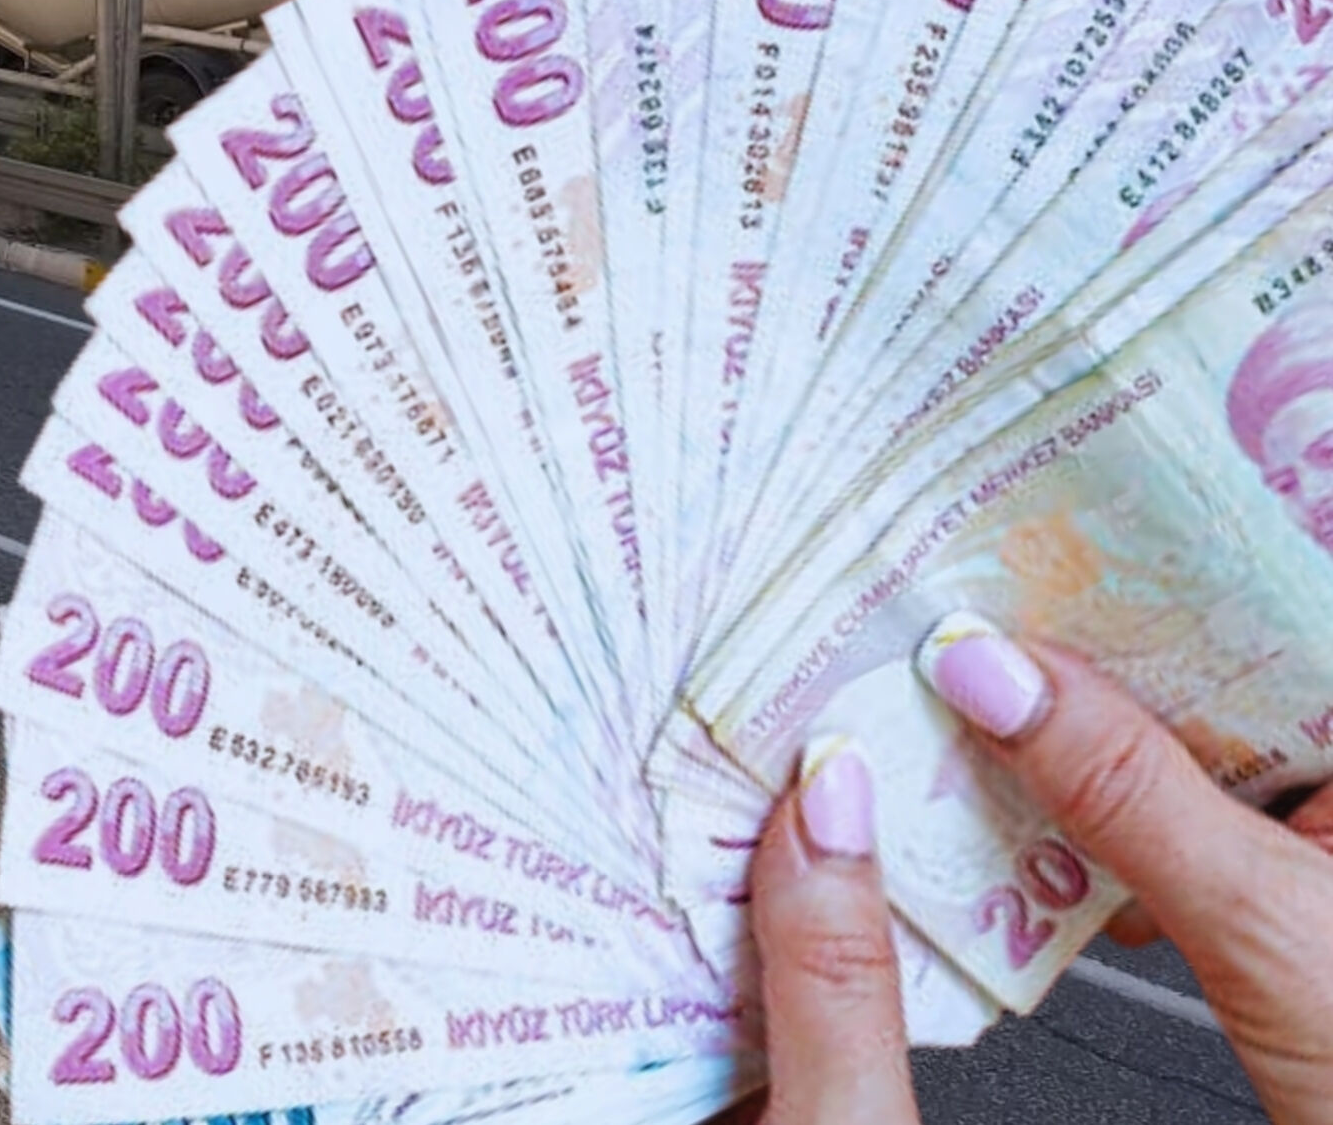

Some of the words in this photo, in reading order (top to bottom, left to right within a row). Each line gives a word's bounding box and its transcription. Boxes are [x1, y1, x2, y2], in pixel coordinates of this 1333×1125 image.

[219, 92, 377, 293] 200
[26, 592, 212, 739] 200
[33, 766, 217, 887] 200
[48, 974, 244, 1086] 200
